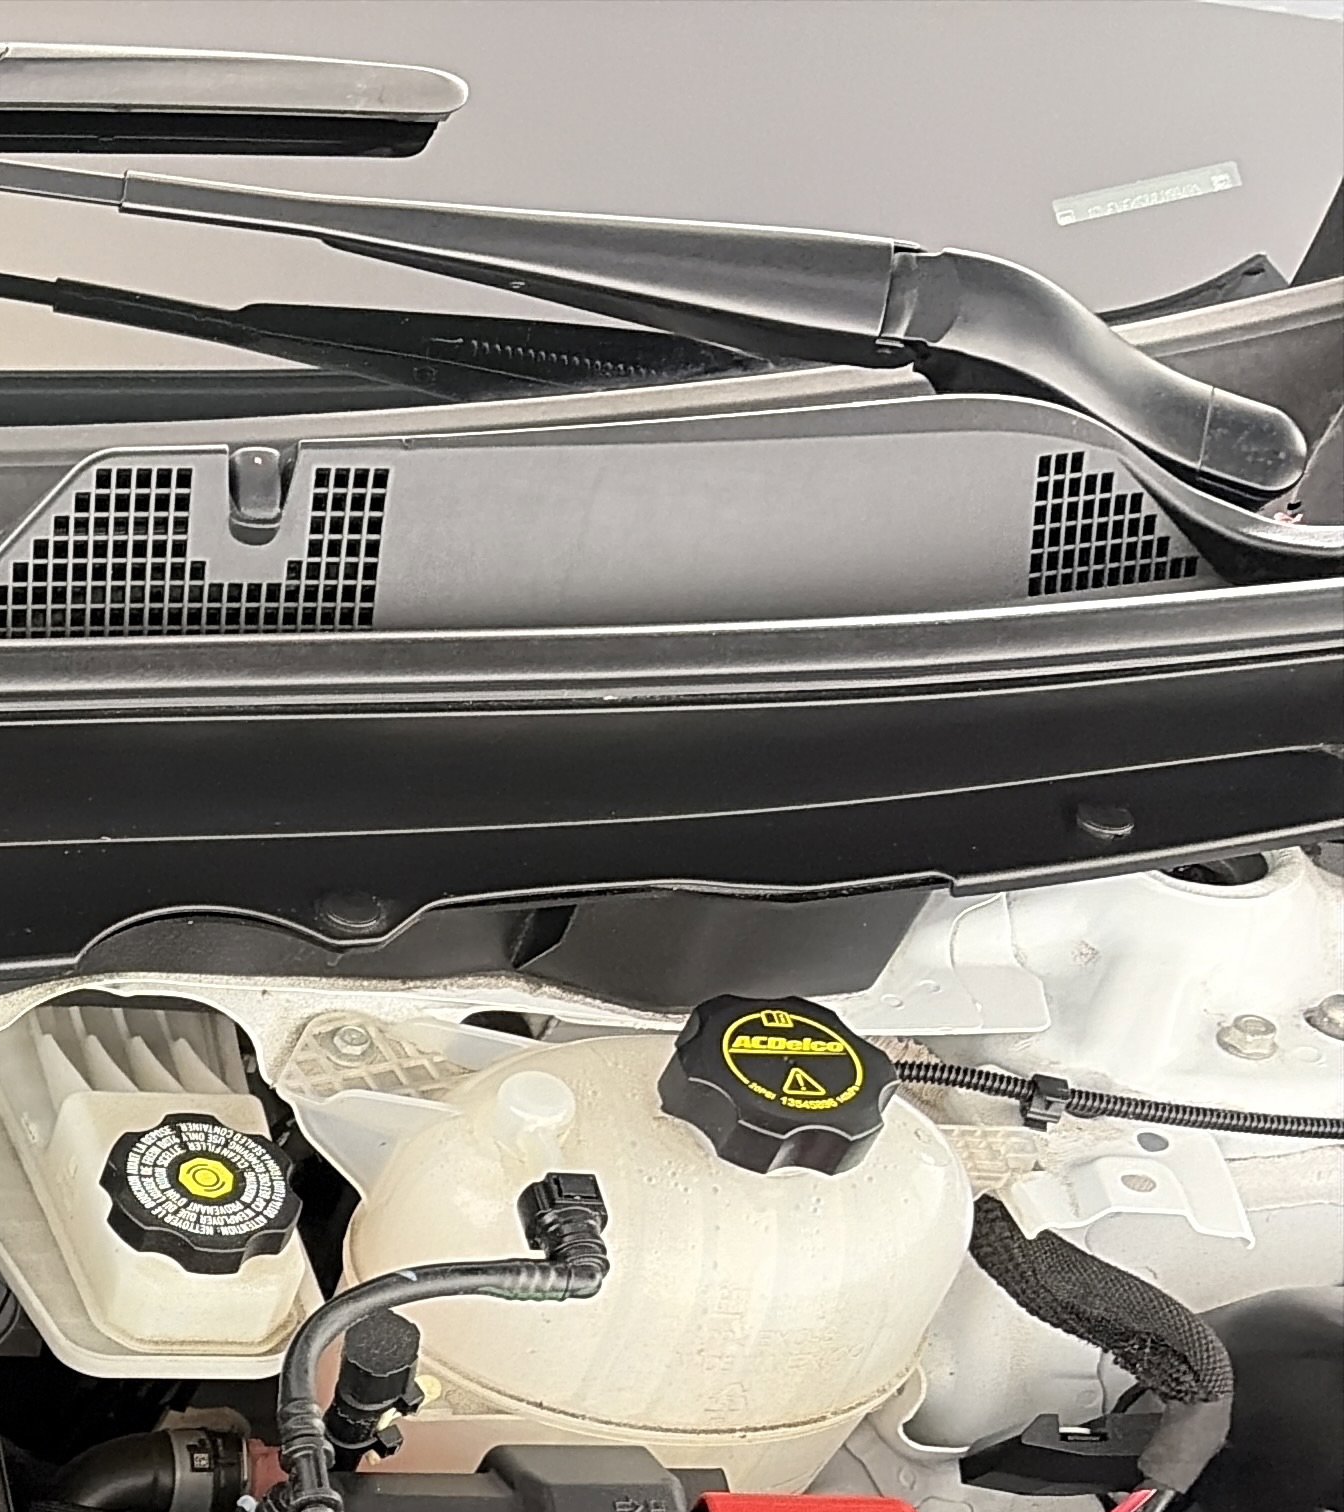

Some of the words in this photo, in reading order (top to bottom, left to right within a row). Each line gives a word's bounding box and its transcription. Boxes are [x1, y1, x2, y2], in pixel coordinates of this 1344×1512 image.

[731, 1035, 845, 1053] ACDelco
[178, 1131, 205, 1142] ONLY
[206, 1132, 227, 1145] USE
[232, 1131, 267, 1156] SEALED
[185, 1140, 223, 1153] FILLER
[219, 1146, 251, 1169] CLEAN
[259, 1152, 273, 1161] A
[159, 1199, 178, 1214] DU
[184, 1199, 246, 1216] PROVENANT
[174, 1207, 197, 1223] QUE
[161, 1212, 214, 1236] NETTOYER
[215, 1213, 270, 1236] ATTENTION:
